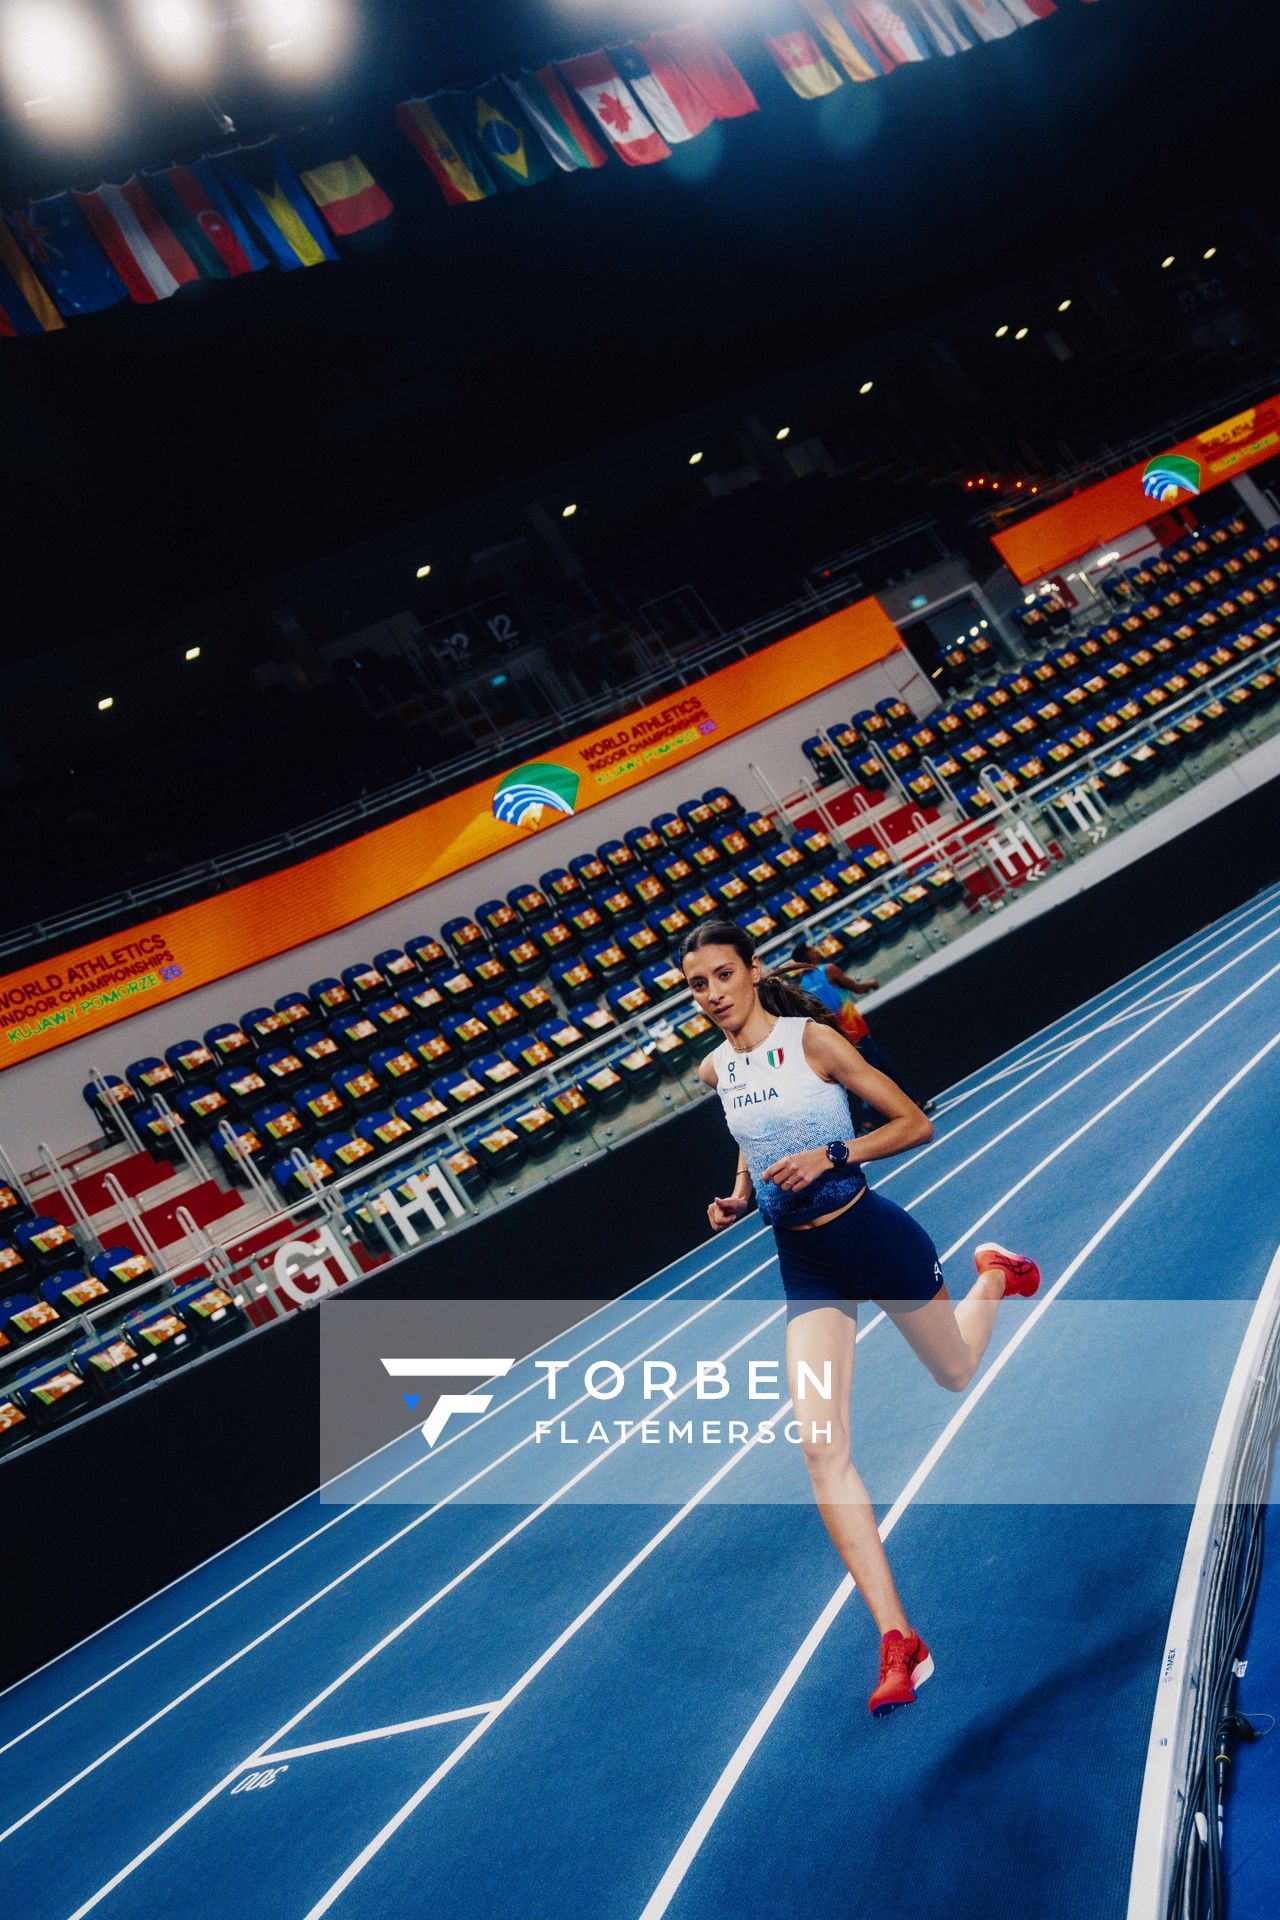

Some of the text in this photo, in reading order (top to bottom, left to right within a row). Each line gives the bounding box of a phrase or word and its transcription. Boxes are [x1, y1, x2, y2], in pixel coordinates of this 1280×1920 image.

[579, 696, 702, 761] WORLD ATHLETICS
[588, 709, 709, 772] INDOOR CHAMPIONSHIPS
[988, 820, 1048, 877] H1
[59, 950, 174, 1003] CHAMPIONSHIPS
[67, 934, 166, 985] ATHLETICS
[7, 964, 183, 1043] KUJAWY POMORZE 26
[733, 1087, 779, 1109] ITALIA
[380, 1163, 465, 1246] H1
